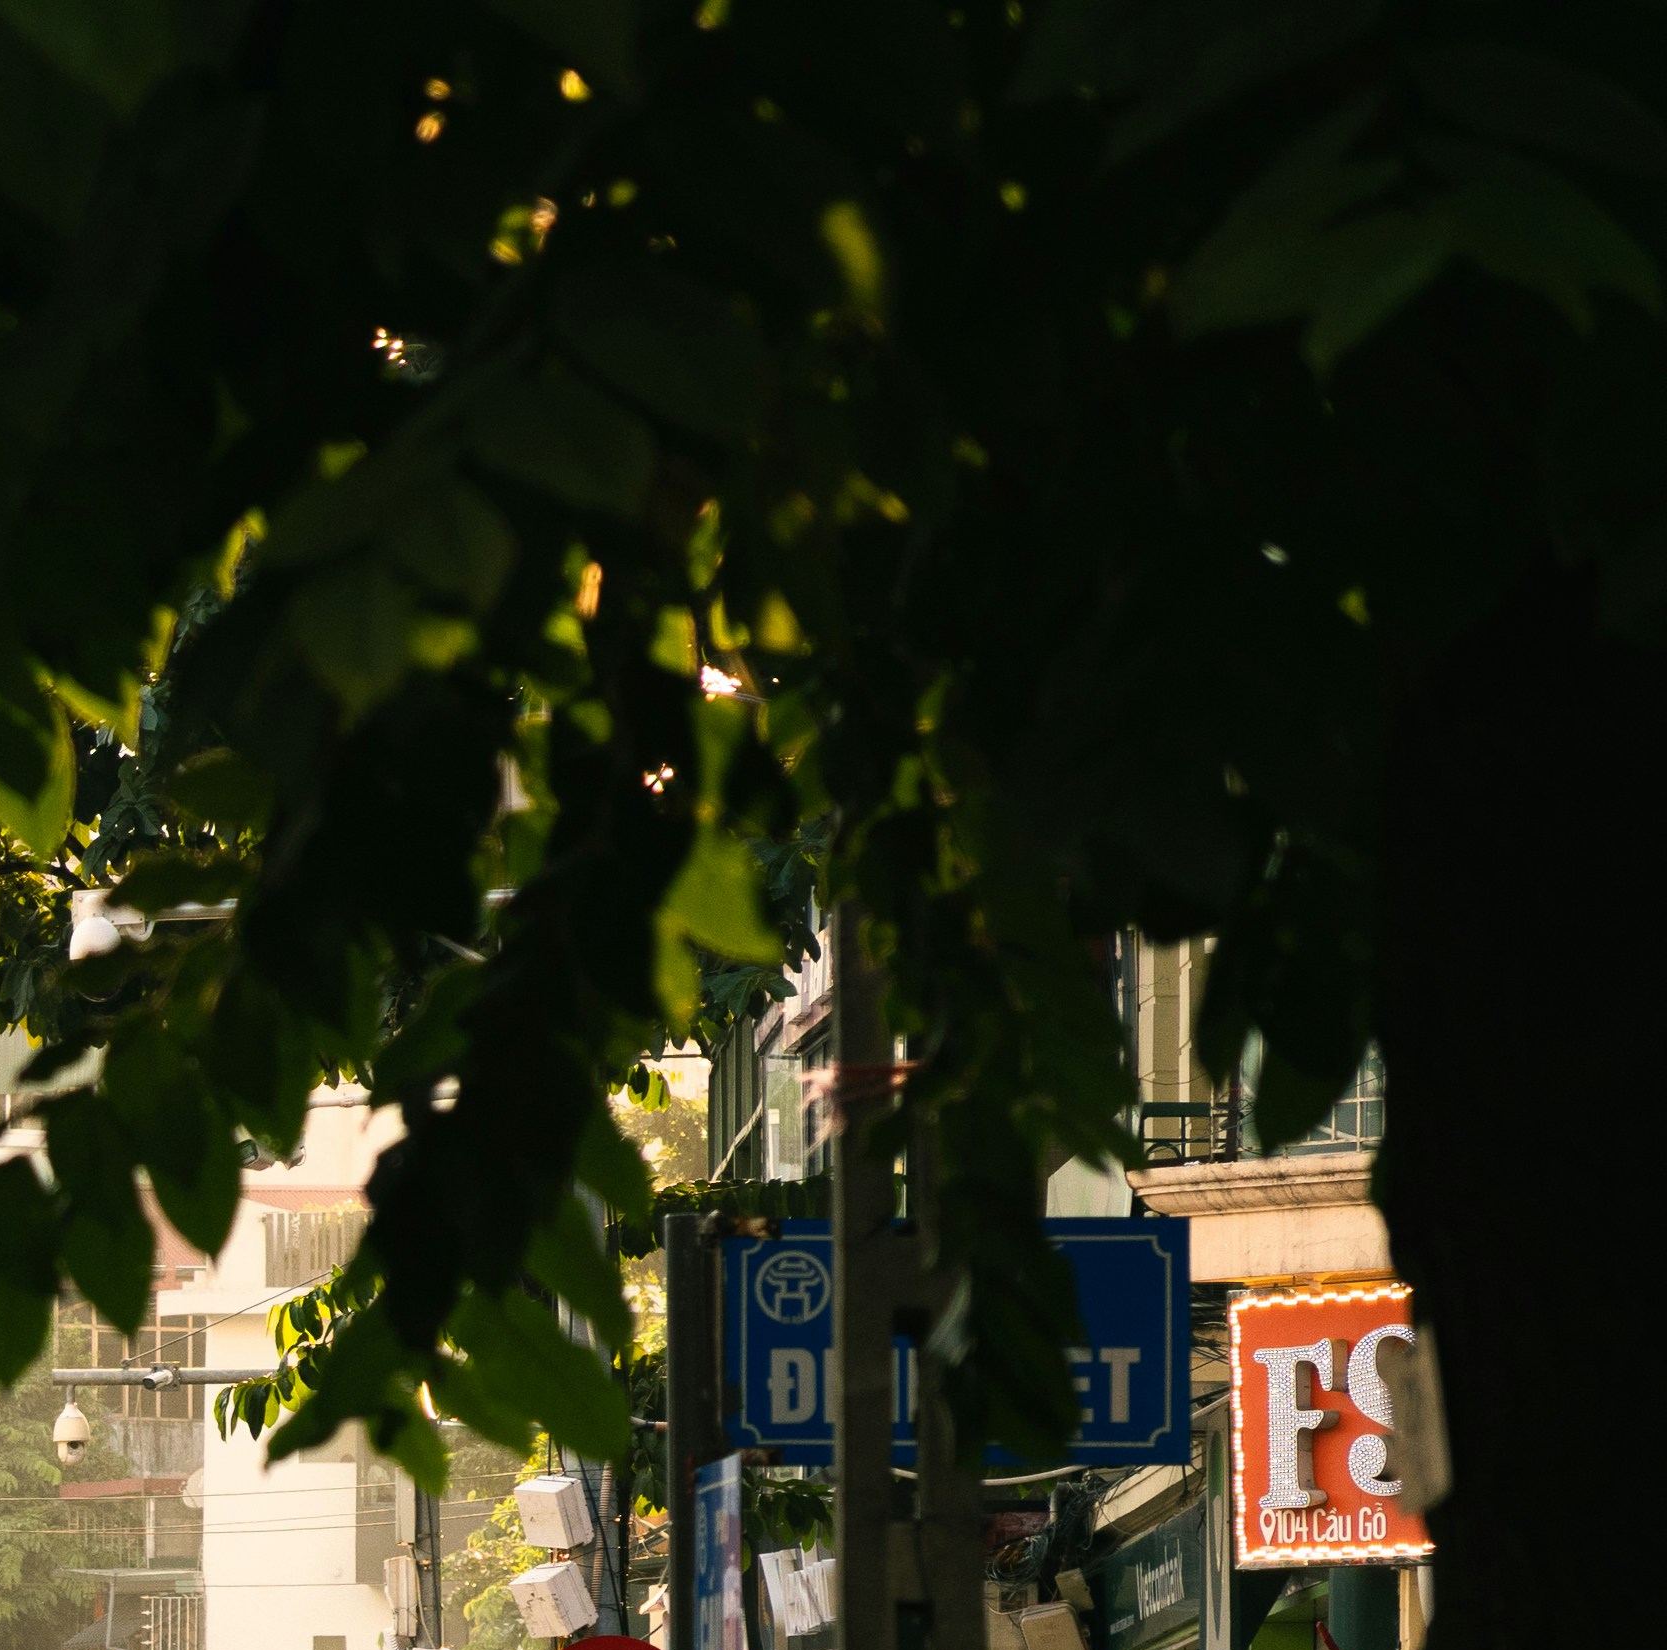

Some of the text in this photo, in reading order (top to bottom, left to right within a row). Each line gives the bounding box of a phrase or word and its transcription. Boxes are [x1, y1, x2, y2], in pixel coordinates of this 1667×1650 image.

[1276, 1499, 1386, 1545] 104 Cầu Gỗ
[1136, 1538, 1185, 1621] Vietcombank
